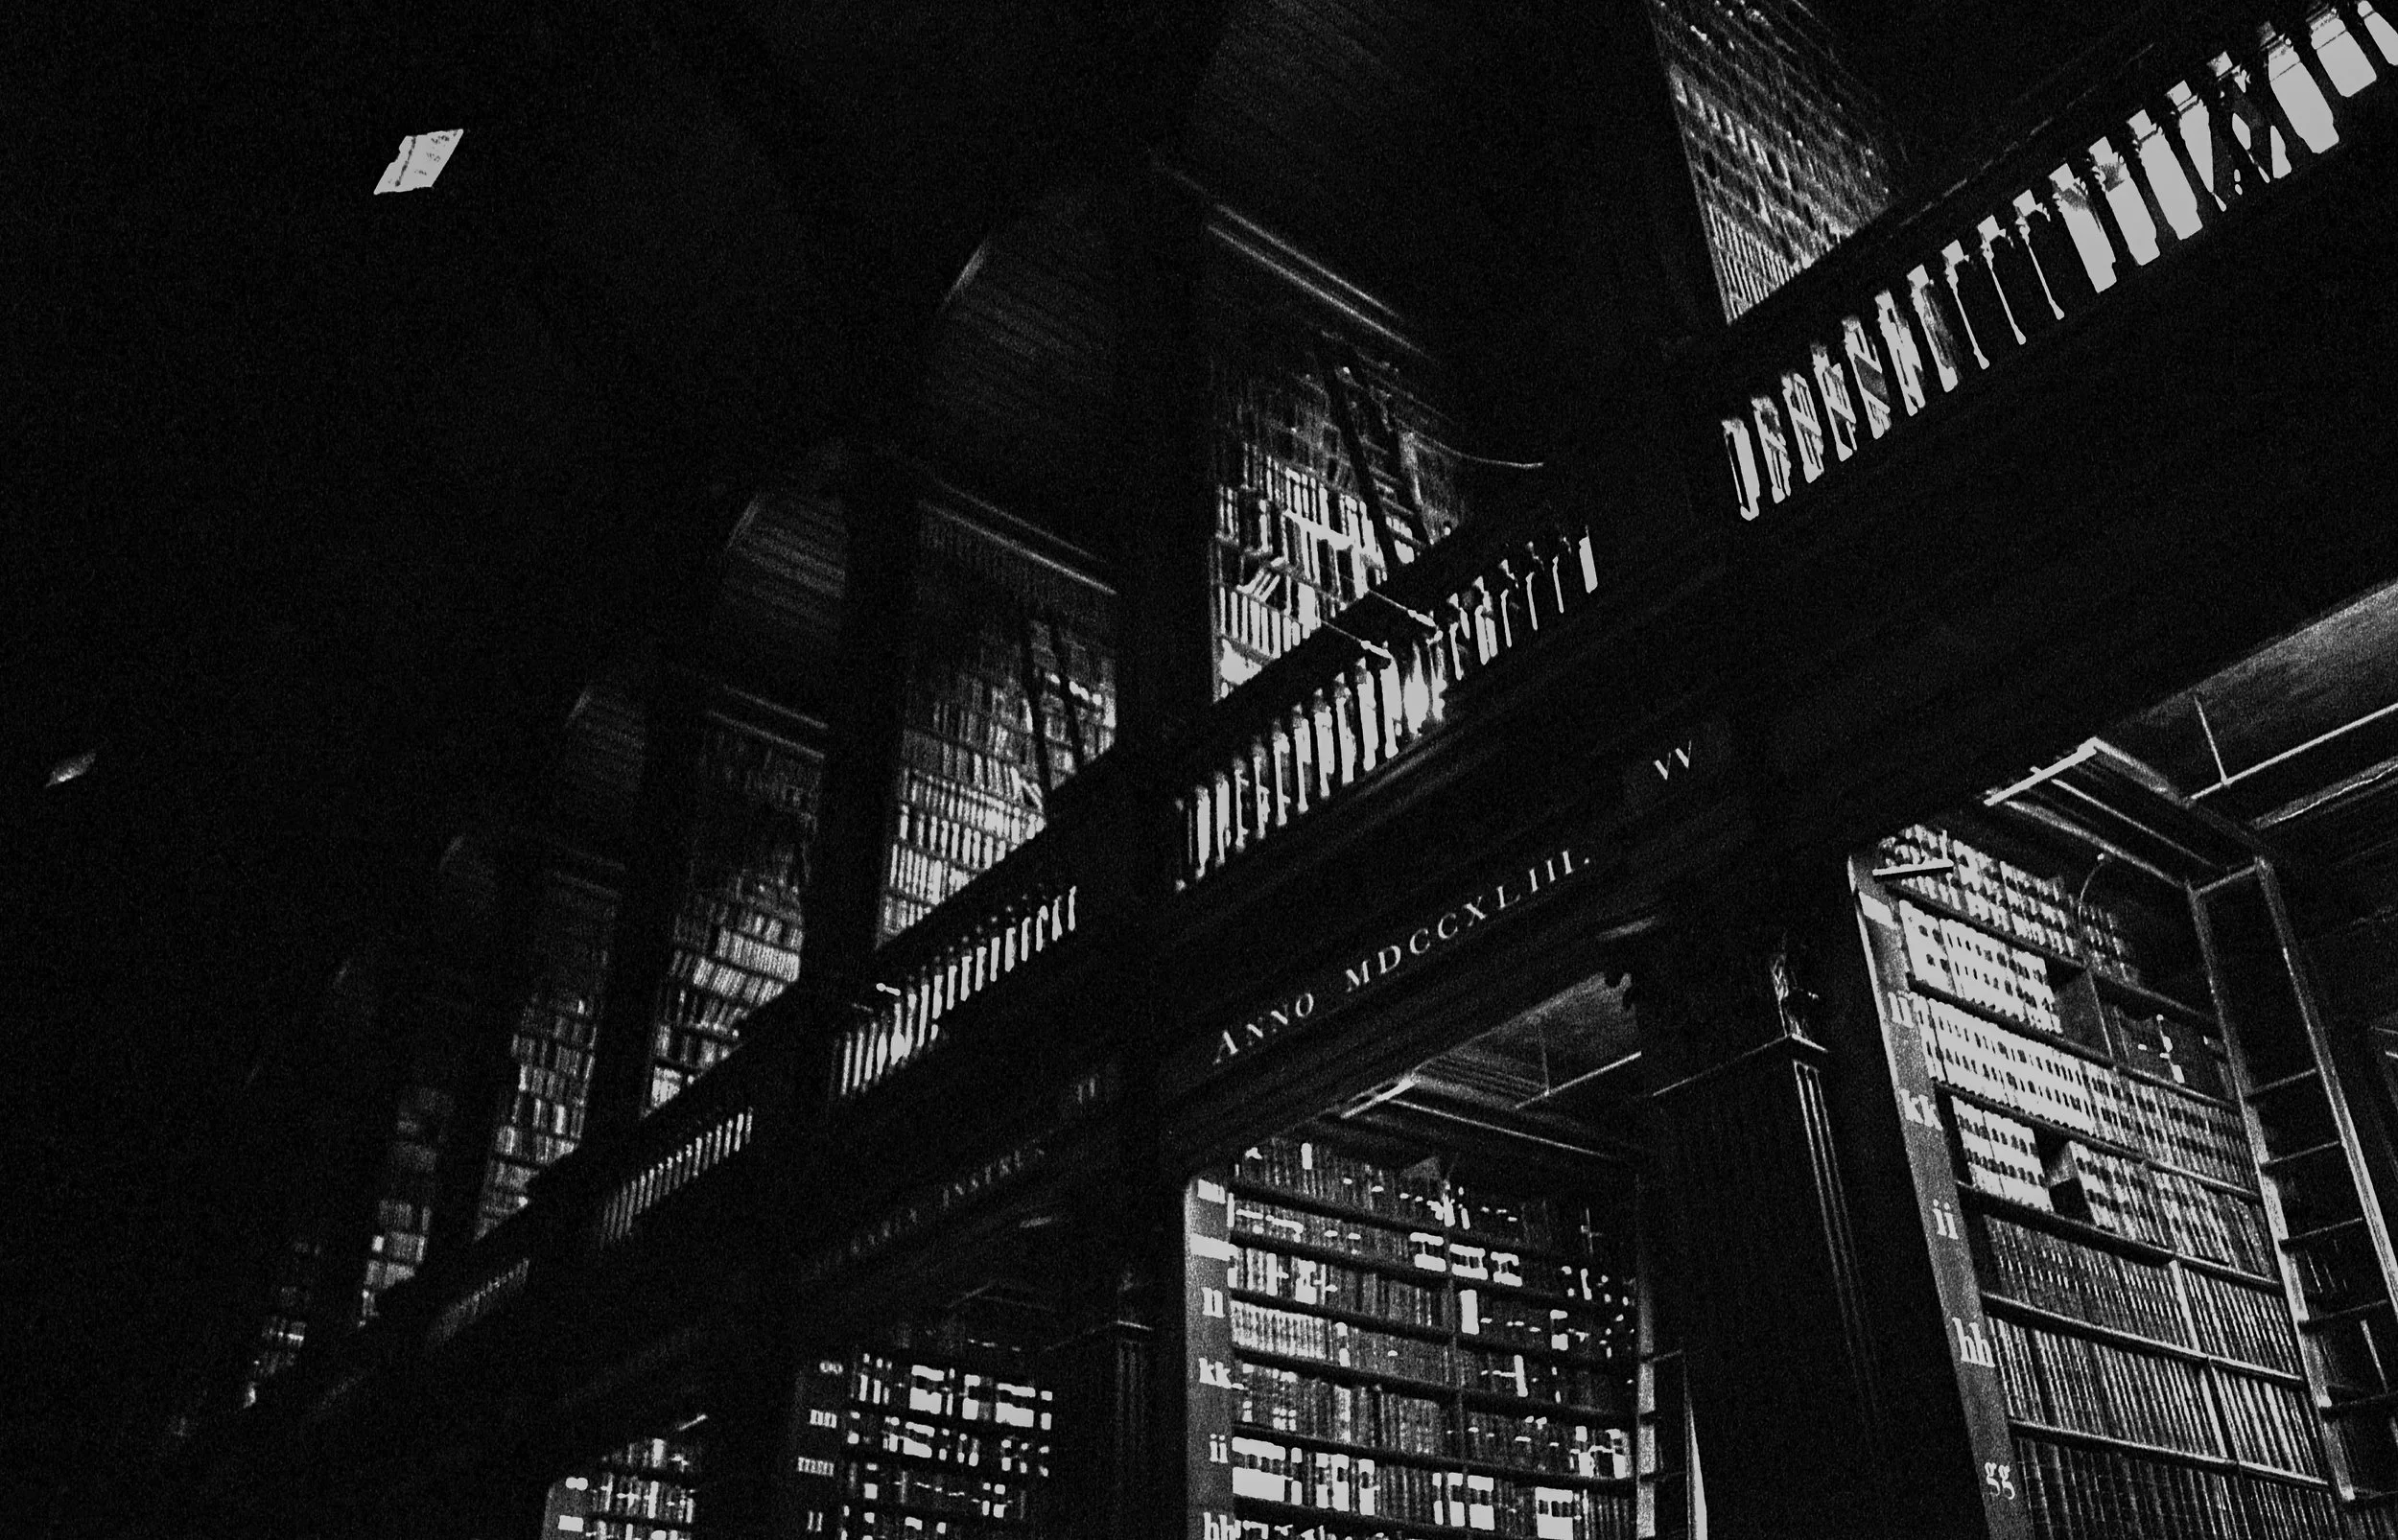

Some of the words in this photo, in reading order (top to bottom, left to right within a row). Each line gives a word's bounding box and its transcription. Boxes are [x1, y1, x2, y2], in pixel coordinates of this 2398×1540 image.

[1899, 1088, 1943, 1131] kk
[1933, 1199, 1959, 1241] ii
[1952, 1317, 1996, 1368] hh
[1199, 1357, 1233, 1388] kk
[1211, 1434, 1229, 1464] ii
[1984, 1462, 2016, 1501] gg
